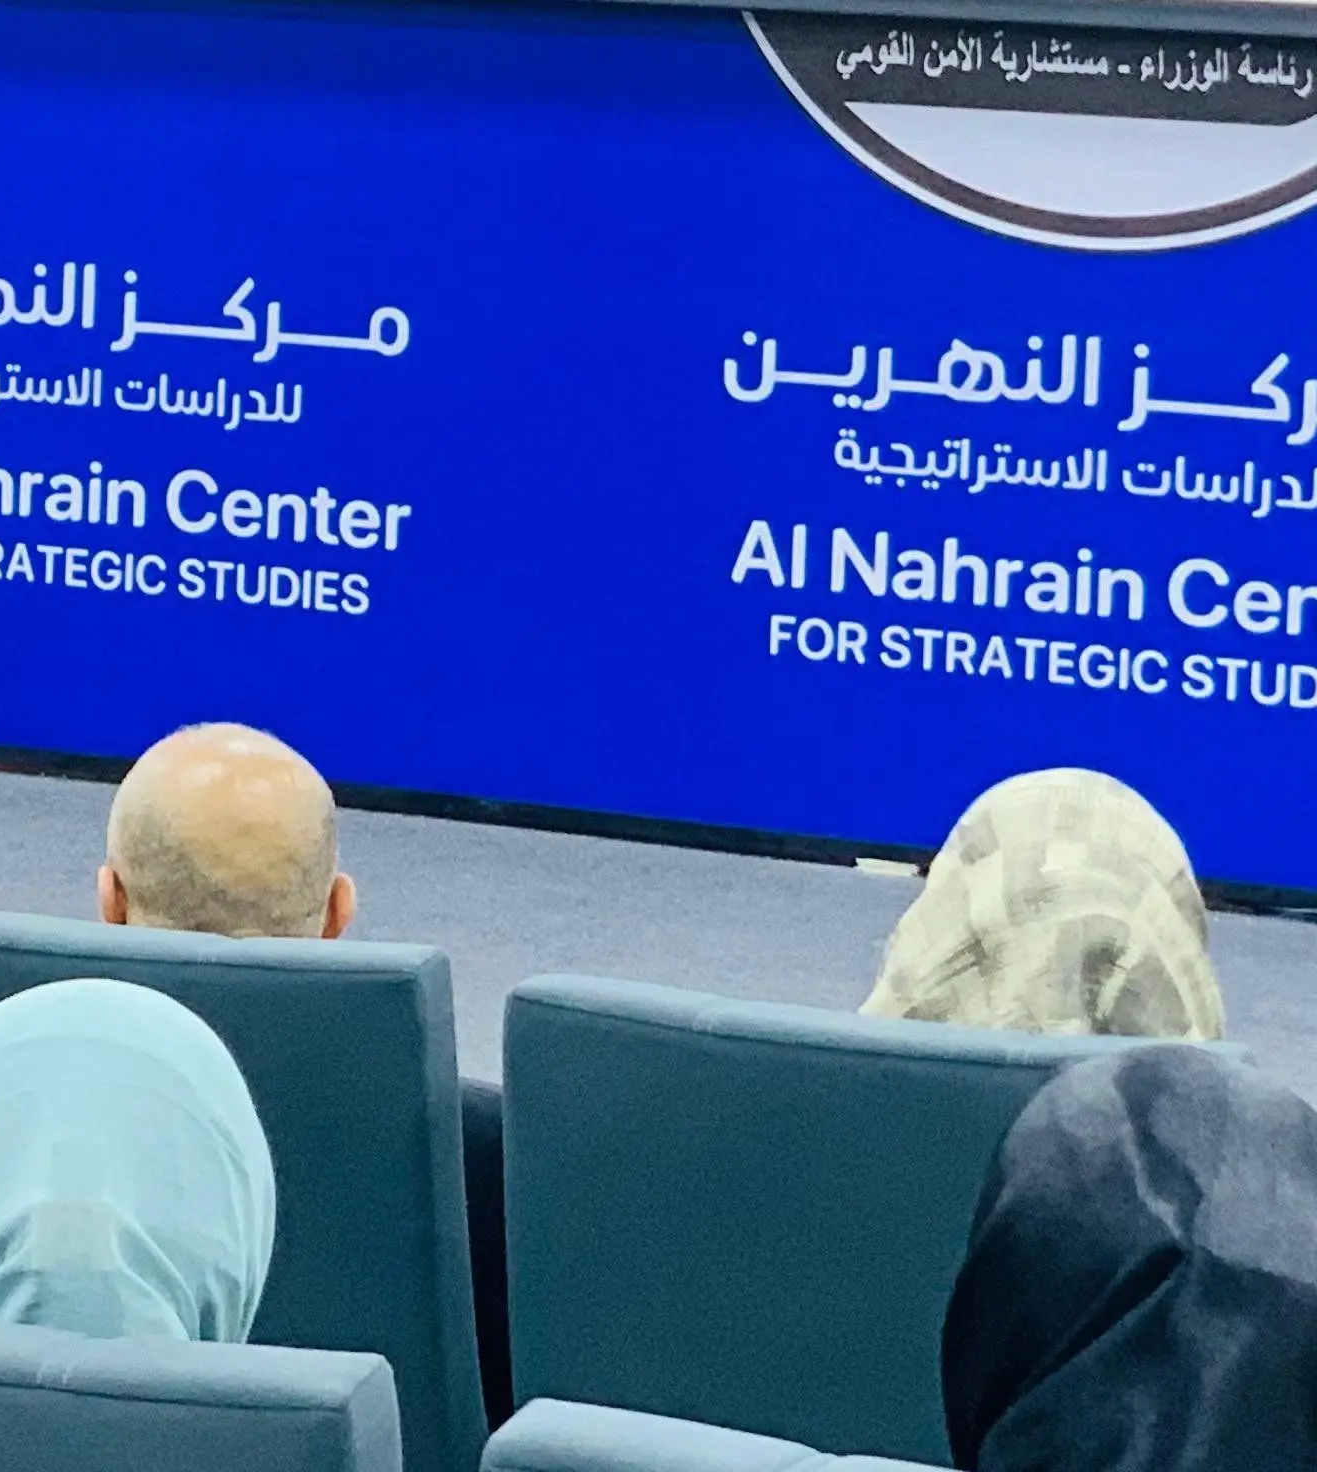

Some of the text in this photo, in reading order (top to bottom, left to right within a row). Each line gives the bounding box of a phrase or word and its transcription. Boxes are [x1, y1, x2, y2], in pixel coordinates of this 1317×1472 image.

[836, 31, 913, 80] القومي
[990, 31, 1109, 81] مستشارية
[1140, 48, 1228, 92] الوزراء
[111, 271, 409, 361] مركز
[115, 374, 301, 429] للدراسات
[724, 332, 1100, 410] النهرين
[835, 429, 1106, 493] الاستراتيجية
[167, 470, 411, 550] Center
[179, 559, 368, 614] STUDIES
[732, 520, 806, 588] Al
[831, 528, 1143, 619] Nahrain
[770, 615, 867, 664] FOR
[881, 626, 1167, 693] STRATEGIC
